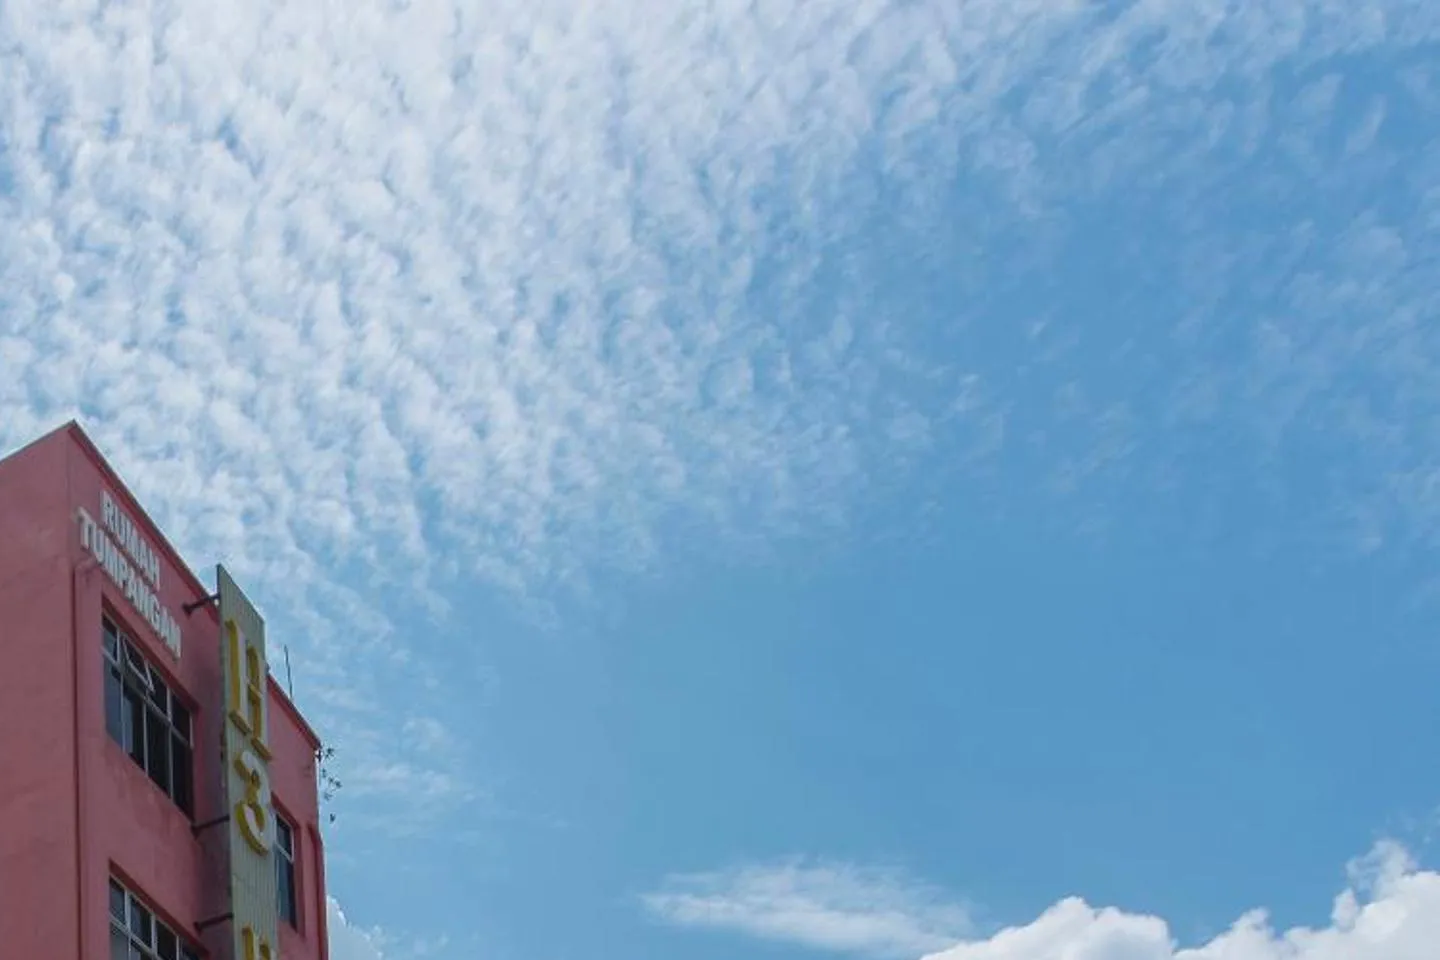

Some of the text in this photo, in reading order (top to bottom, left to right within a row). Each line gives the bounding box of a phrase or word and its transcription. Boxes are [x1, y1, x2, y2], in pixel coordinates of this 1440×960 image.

[76, 506, 181, 661] TUMPANGAN
[100, 490, 160, 592] RUMAH
[224, 618, 273, 857] H3
